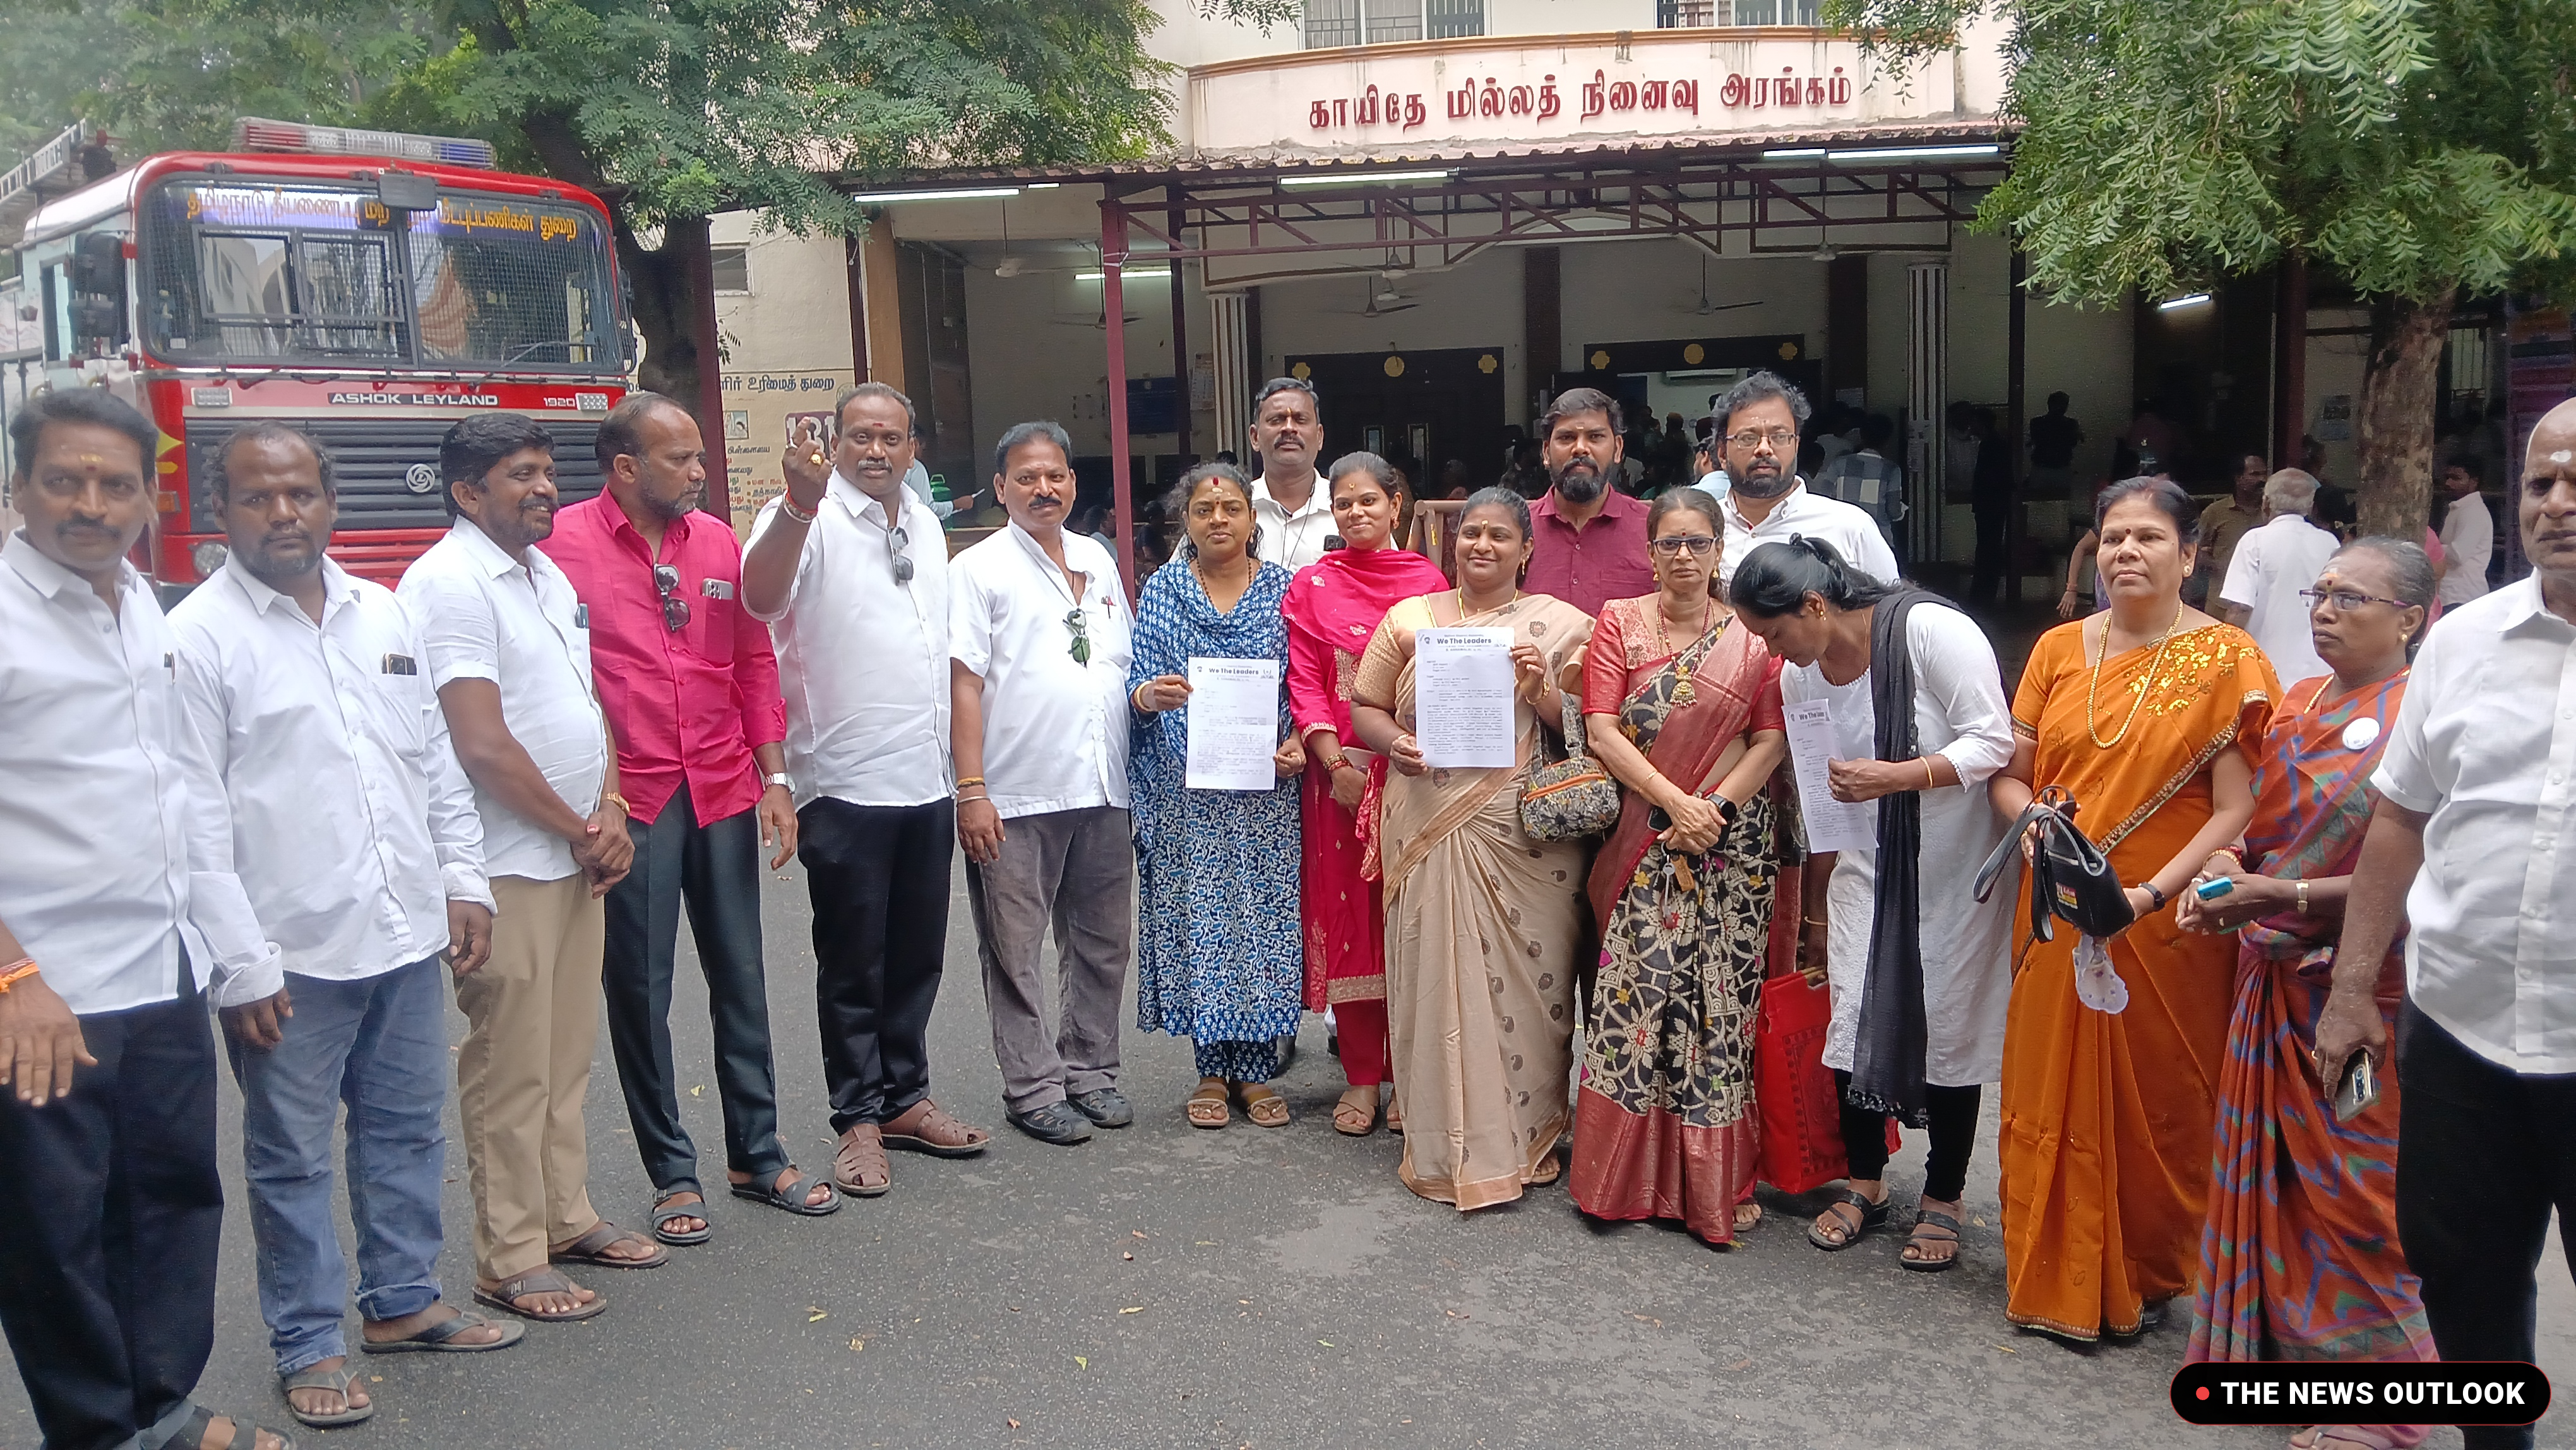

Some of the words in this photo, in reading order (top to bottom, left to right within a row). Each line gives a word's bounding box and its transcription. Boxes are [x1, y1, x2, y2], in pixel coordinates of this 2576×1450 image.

[1309, 83, 1426, 133] காயிதே
[1446, 74, 1561, 125] மில்லத்
[1580, 69, 1699, 123] நினைவு
[1720, 66, 1852, 108] அரங்கம்
[800, 376, 835, 392] துறை
[331, 393, 401, 404] ASHOK
[412, 394, 499, 405] LEYLAND
[543, 397, 576, 407] 1920
